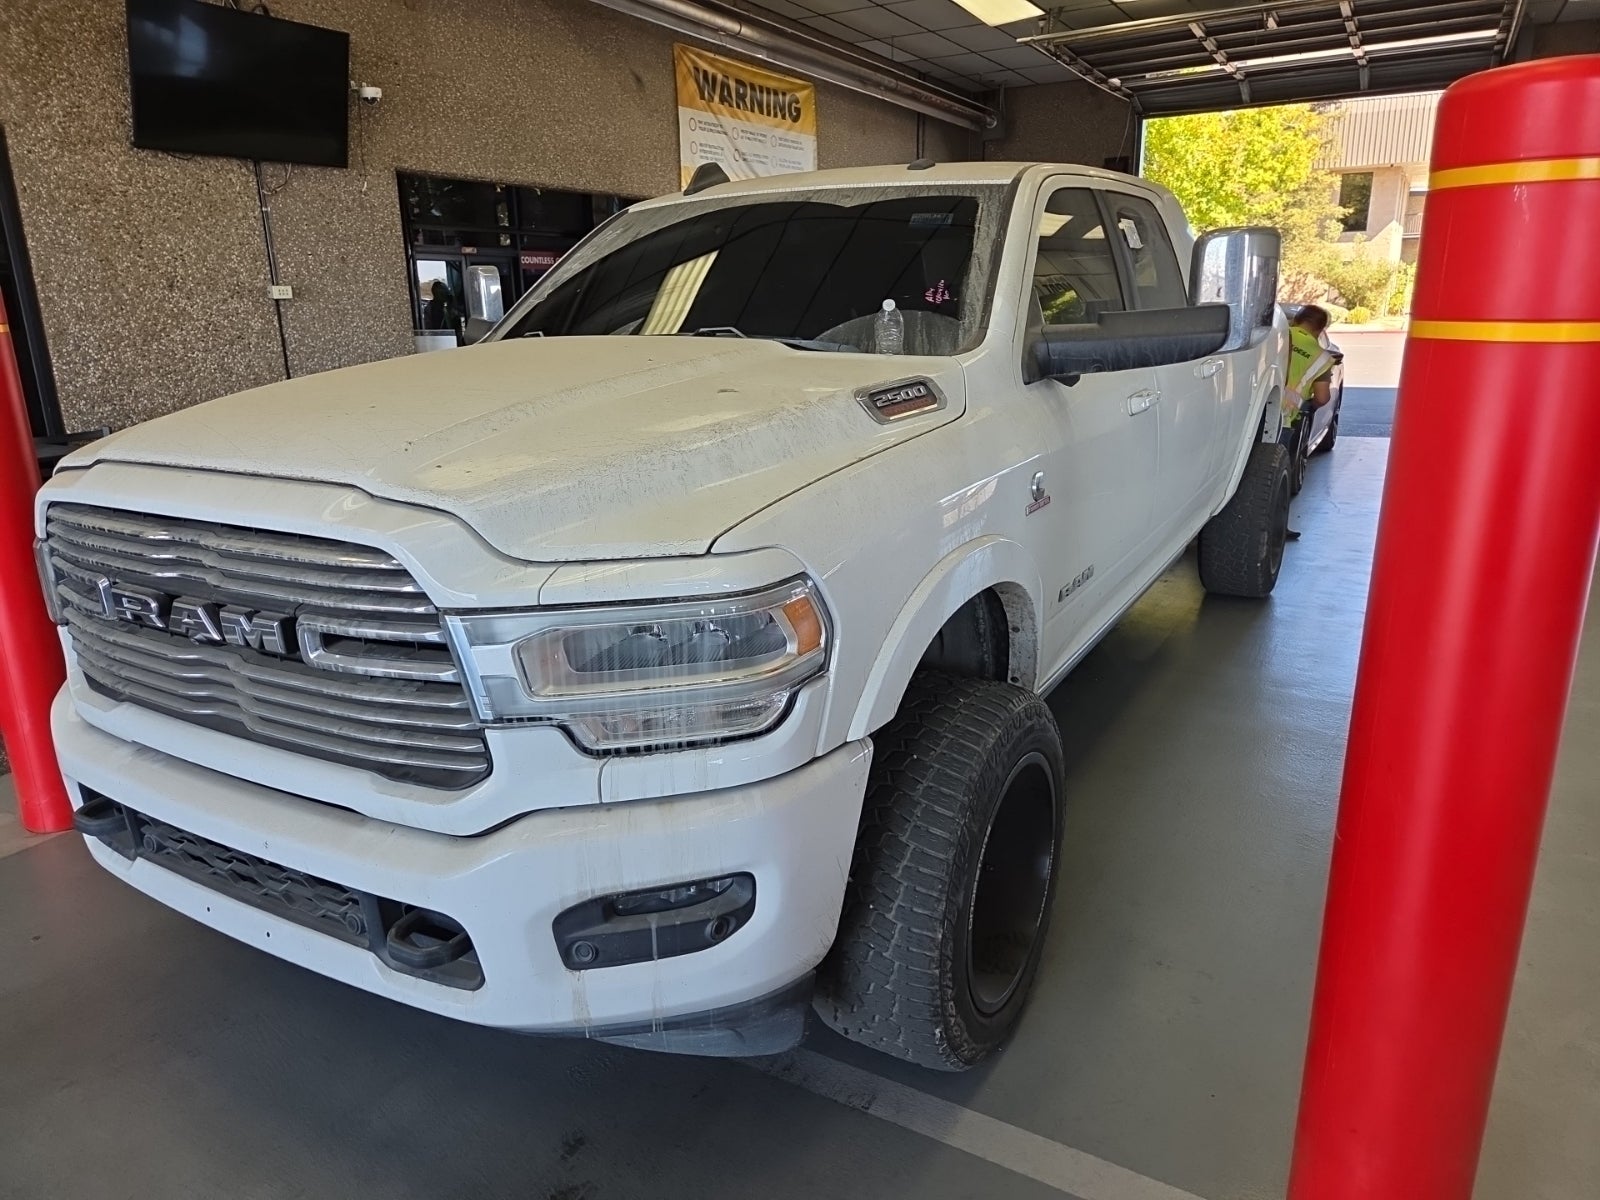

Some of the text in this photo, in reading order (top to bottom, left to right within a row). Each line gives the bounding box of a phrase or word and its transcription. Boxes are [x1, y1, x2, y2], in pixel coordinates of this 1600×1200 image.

[693, 66, 801, 123] WARNING
[520, 256, 554, 265] COUNTLESS
[874, 385, 927, 407] 2500
[111, 585, 287, 655] RAM
